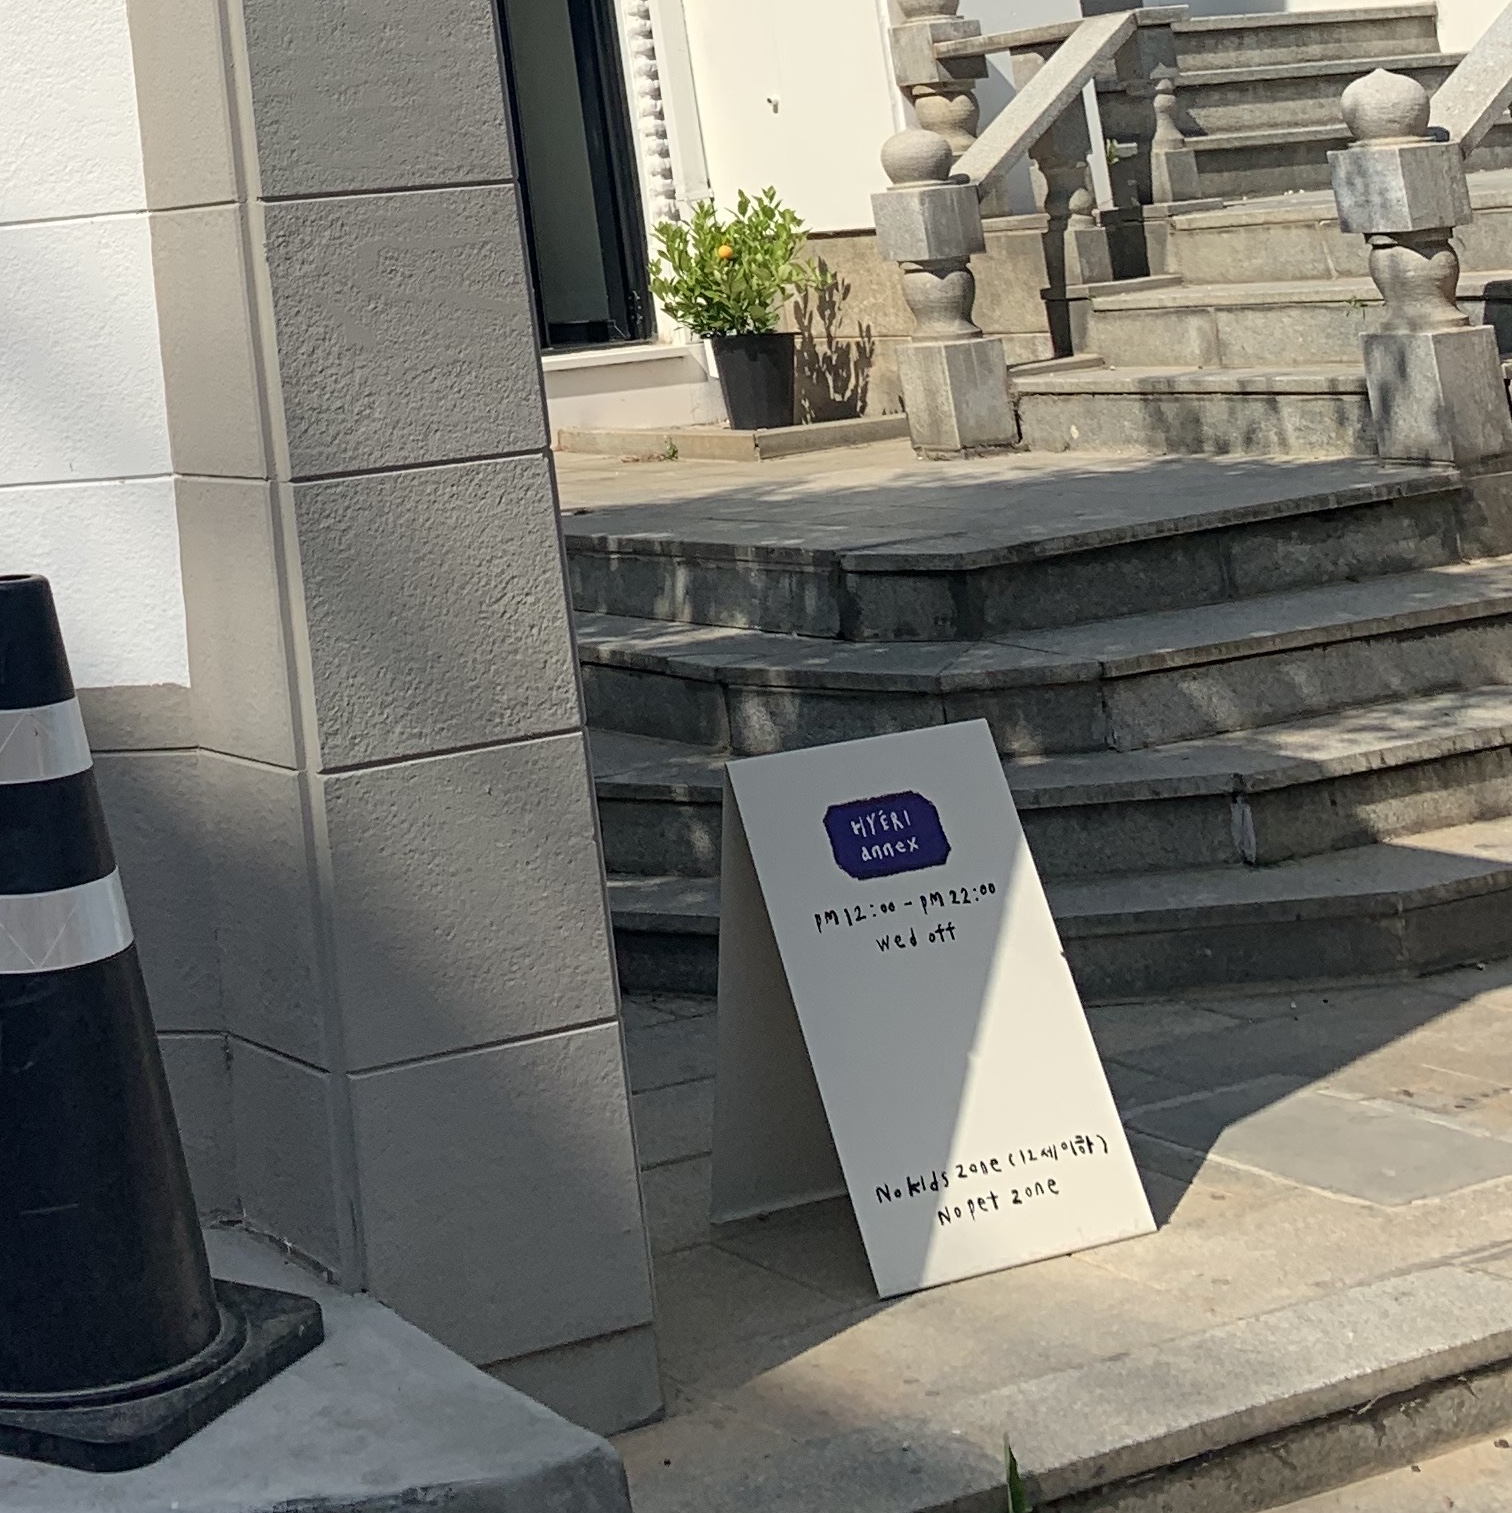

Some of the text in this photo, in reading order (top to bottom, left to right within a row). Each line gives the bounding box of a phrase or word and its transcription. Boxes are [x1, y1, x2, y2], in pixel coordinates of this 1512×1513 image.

[861, 837, 919, 862] annex
[949, 882, 997, 905] 22:00
[928, 921, 956, 942] off
[1011, 1178, 1060, 1205] zone
